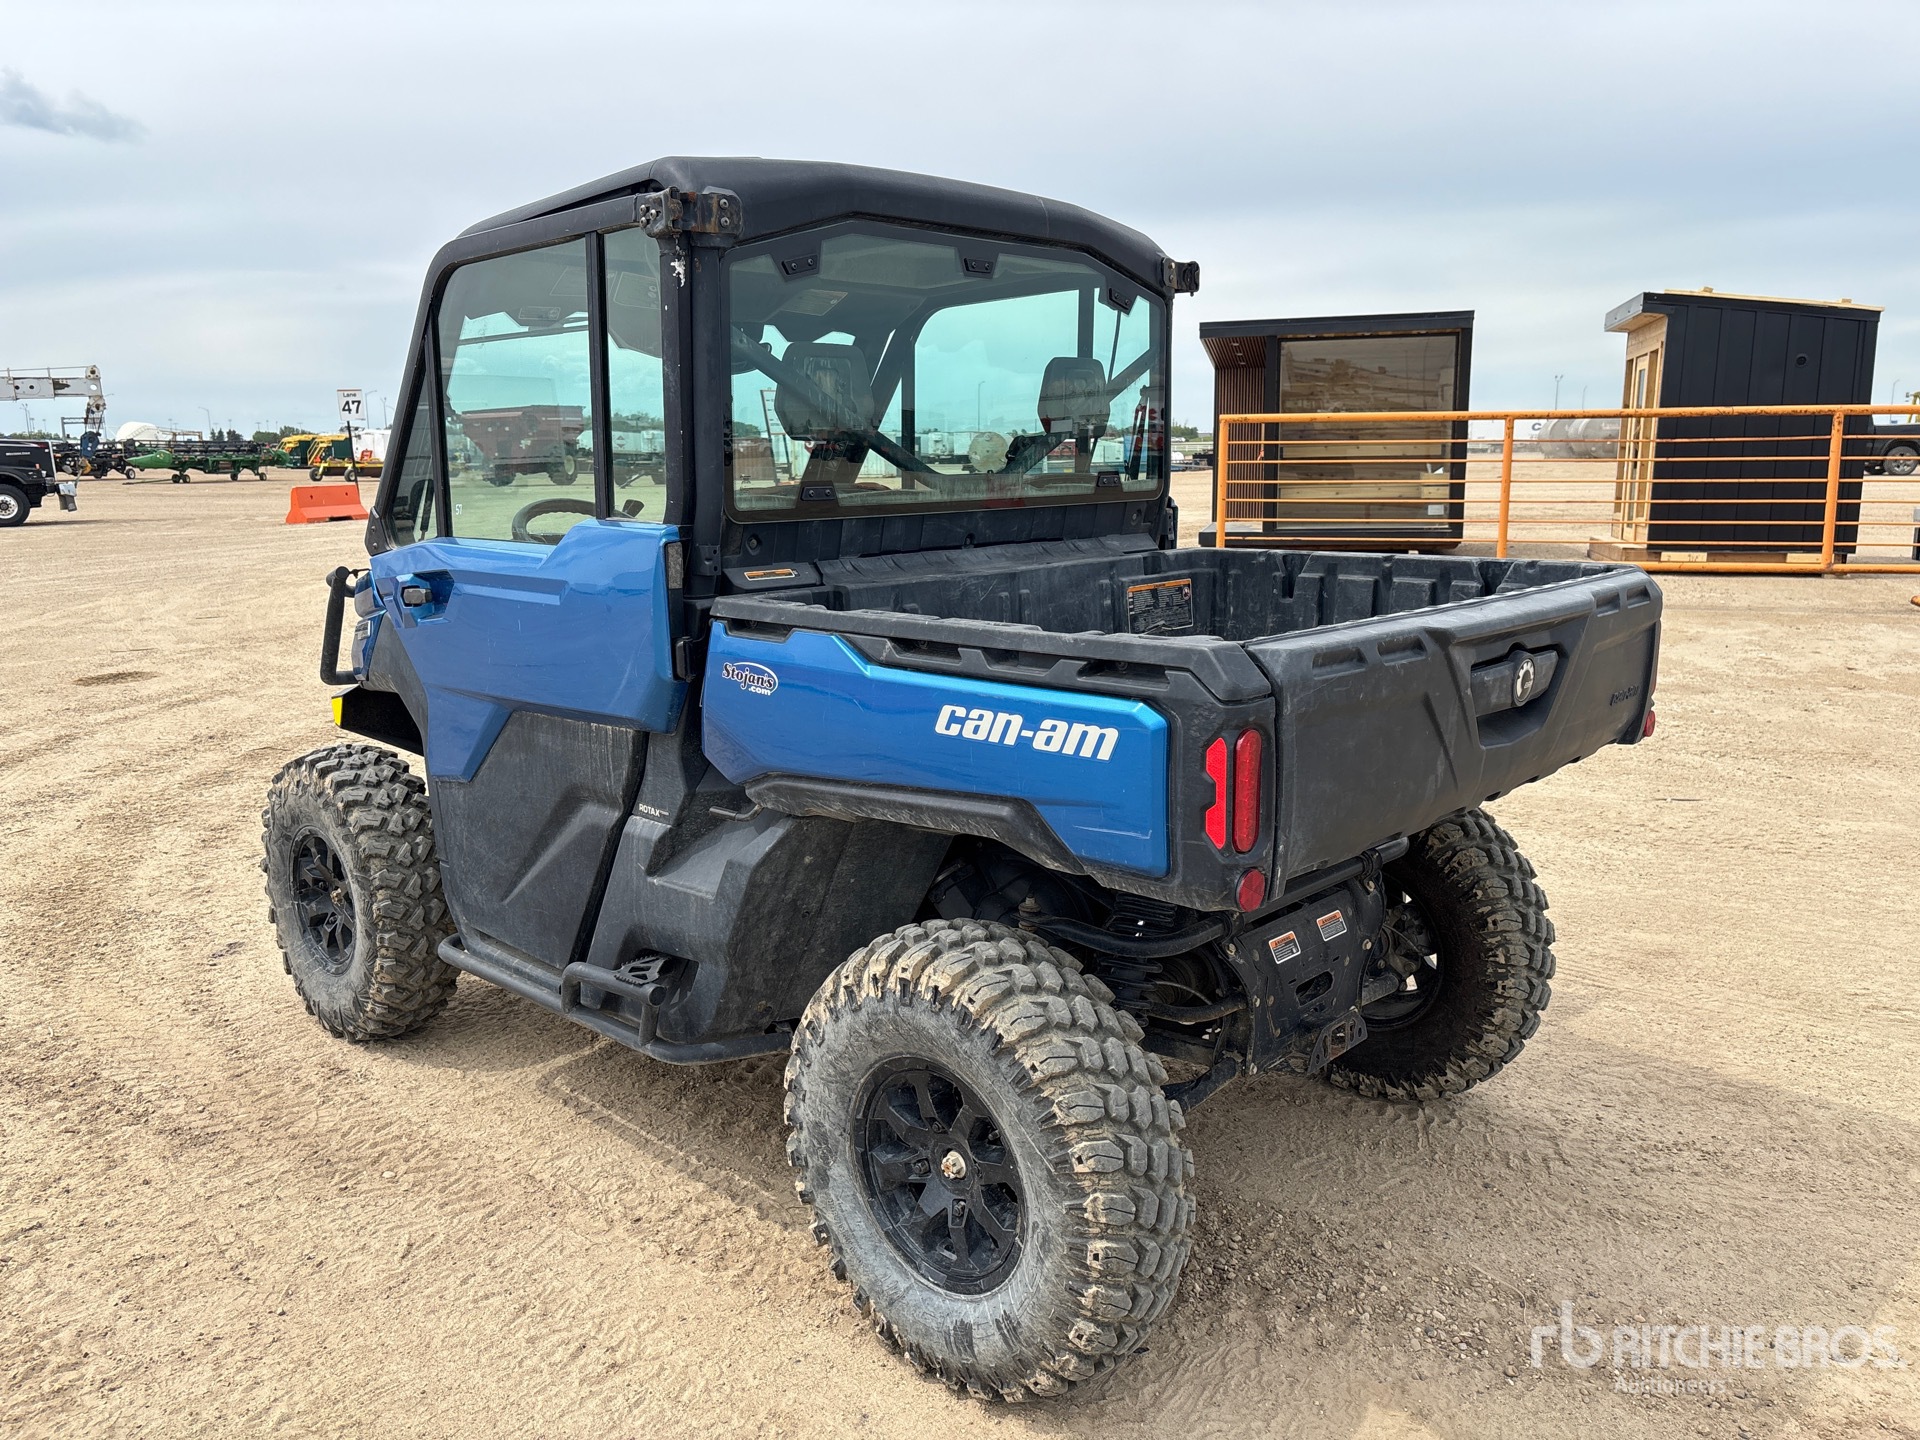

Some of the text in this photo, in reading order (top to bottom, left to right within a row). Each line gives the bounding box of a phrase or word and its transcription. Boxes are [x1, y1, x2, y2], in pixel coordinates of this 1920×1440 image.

[341, 400, 361, 414] 47
[722, 662, 774, 690] Stojan's
[748, 686, 771, 696] .com
[934, 704, 1119, 761] can-am
[638, 803, 660, 817] ROTAX
